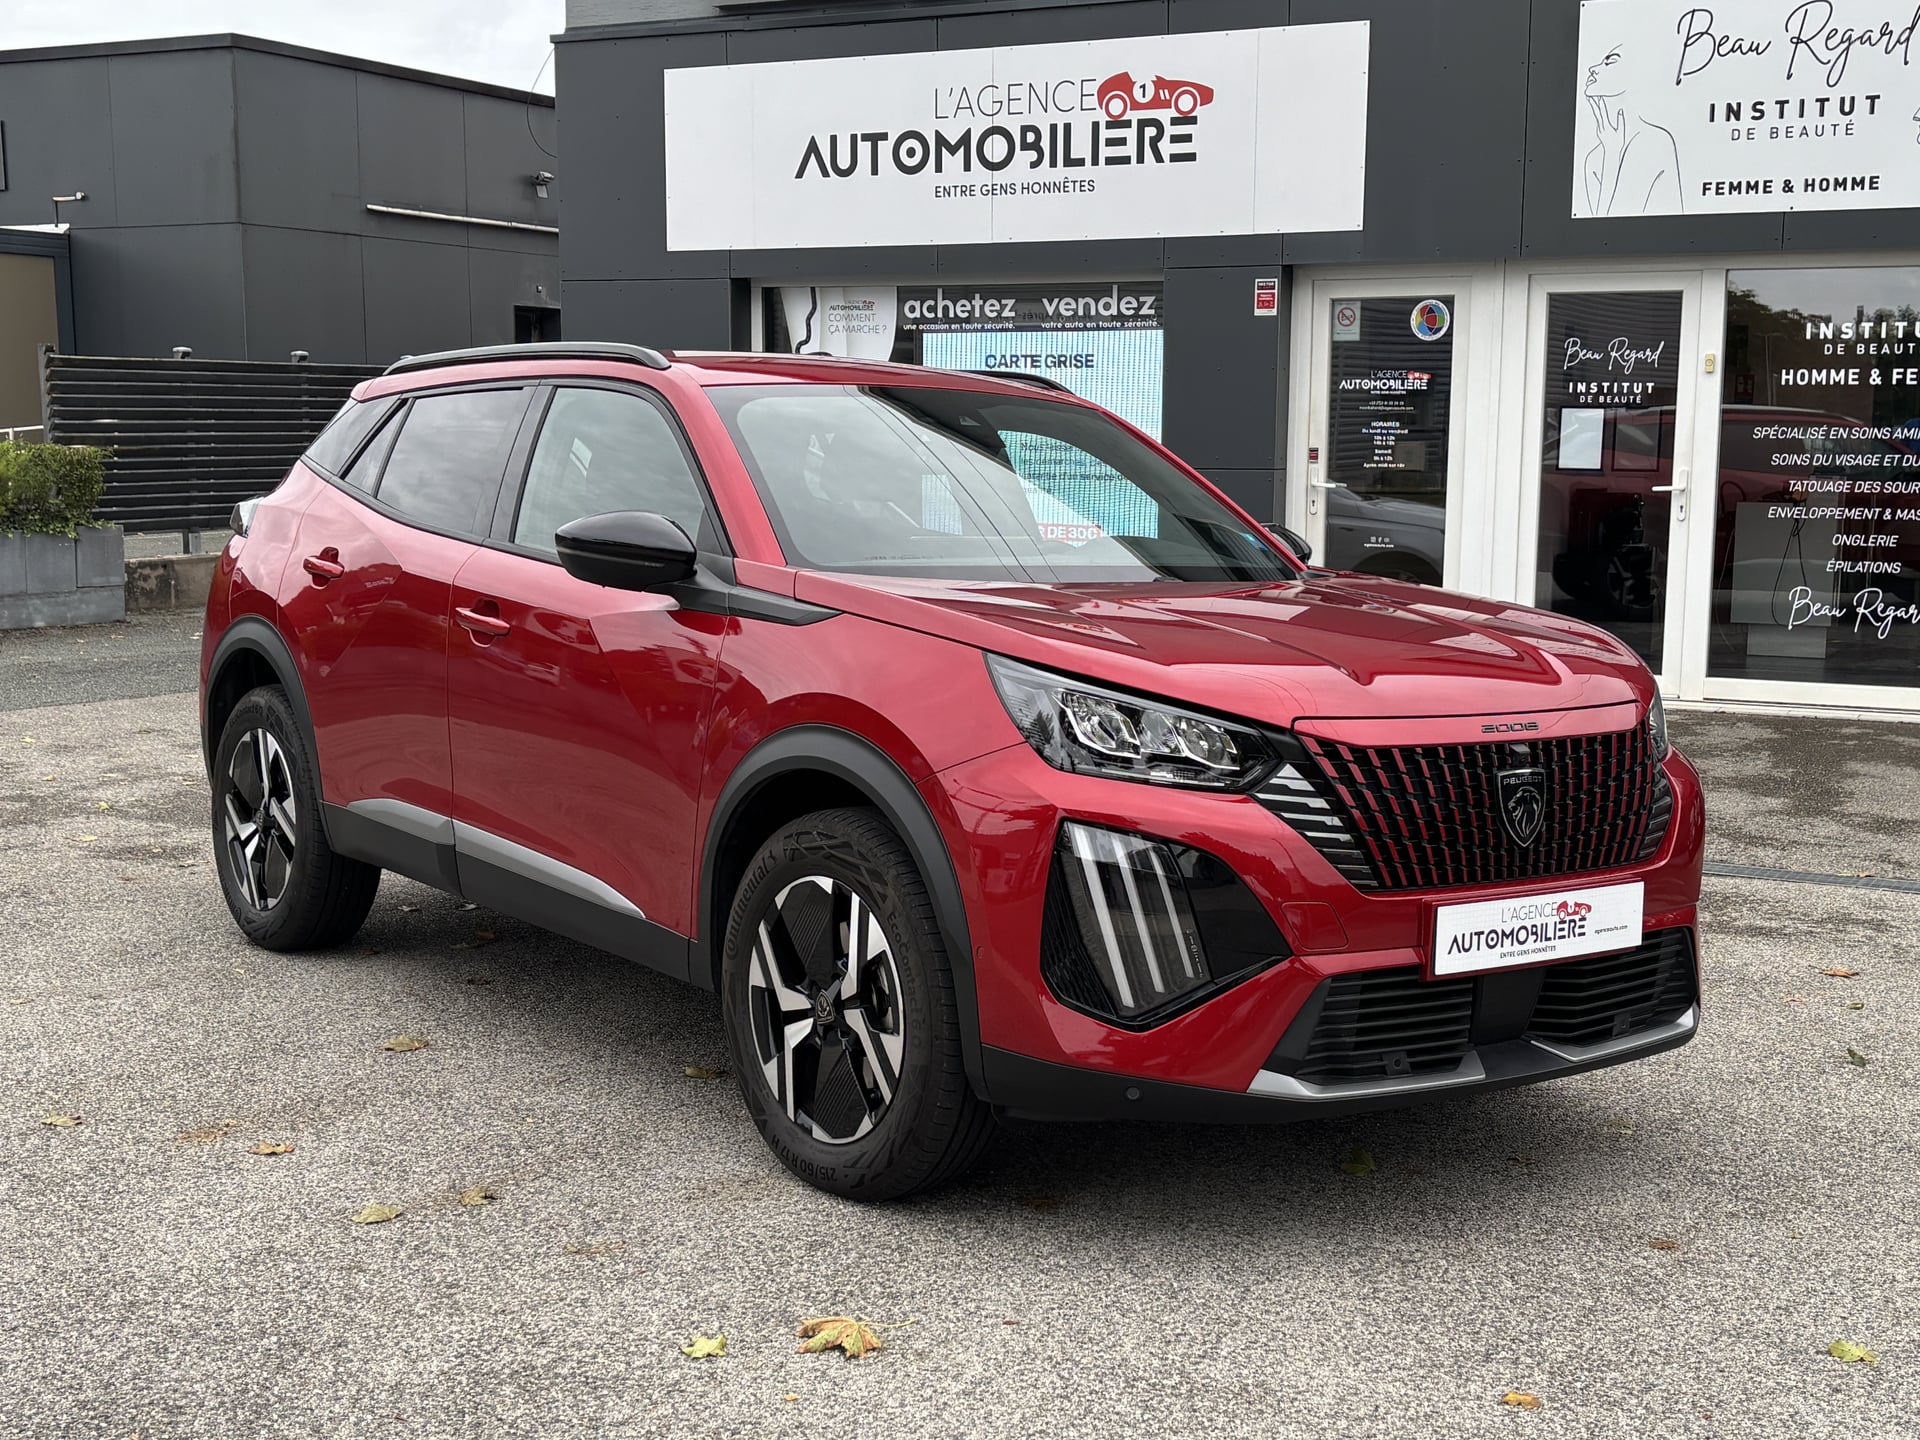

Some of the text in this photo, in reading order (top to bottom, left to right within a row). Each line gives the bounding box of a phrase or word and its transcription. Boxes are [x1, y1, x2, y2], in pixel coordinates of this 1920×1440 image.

[1675, 0, 1920, 88] Beau Regard
[1138, 83, 1147, 98] 1
[933, 78, 1098, 120] L'AGENCE
[1708, 94, 1881, 123] INSTITUT
[1730, 119, 1855, 141] DE BEAUTÉ
[934, 176, 1096, 198] ENTRE GENS HONNÊTES
[1701, 175, 1881, 196] FEMME & HOMME
[903, 287, 1017, 319] achetez
[1041, 284, 1157, 317] vendez
[828, 313, 877, 322] COMMENT
[918, 321, 949, 330] occasion
[962, 321, 982, 330] toute
[984, 320, 1016, 329] sécurité.
[1041, 321, 1062, 329] votre
[1064, 321, 1084, 329] auto
[1099, 320, 1122, 328] toute
[1124, 319, 1161, 328] sérénité.
[828, 324, 887, 335] ÇA MARCHE ?
[1563, 336, 1665, 375] Beau Regard
[1824, 343, 1846, 355] DE
[985, 353, 1095, 369] CARTE GRISE
[1370, 370, 1407, 378] L'AGENCE
[1781, 367, 1919, 386] HOMME & FE
[1568, 381, 1655, 394] INSTITUT
[1579, 393, 1642, 404] DE BEAUTÉ
[1752, 424, 1920, 440] SPÉCIALISÉ EN SOINS AMI
[1770, 453, 1811, 466] SOINS
[1812, 453, 1834, 466] DU
[1834, 454, 1882, 467] VISAGE
[1883, 454, 1902, 467] ET
[1788, 480, 1920, 494] TATOUAGE DES SOUR
[1767, 506, 1882, 520] ENVELOPPEMENT
[1882, 507, 1892, 521] &
[1047, 526, 1067, 538] DE
[1831, 533, 1899, 547] ONGLERIE
[1825, 557, 1902, 574] ÉPILATIONS
[1787, 585, 1847, 631] Beau
[1481, 721, 1539, 734] 2008
[1503, 775, 1543, 786] PEUGEOT
[725, 854, 770, 960] Continental
[1501, 901, 1558, 923] L'AGENCE
[1500, 951, 1516, 959] ENTRE
[1516, 948, 1531, 957] GENS
